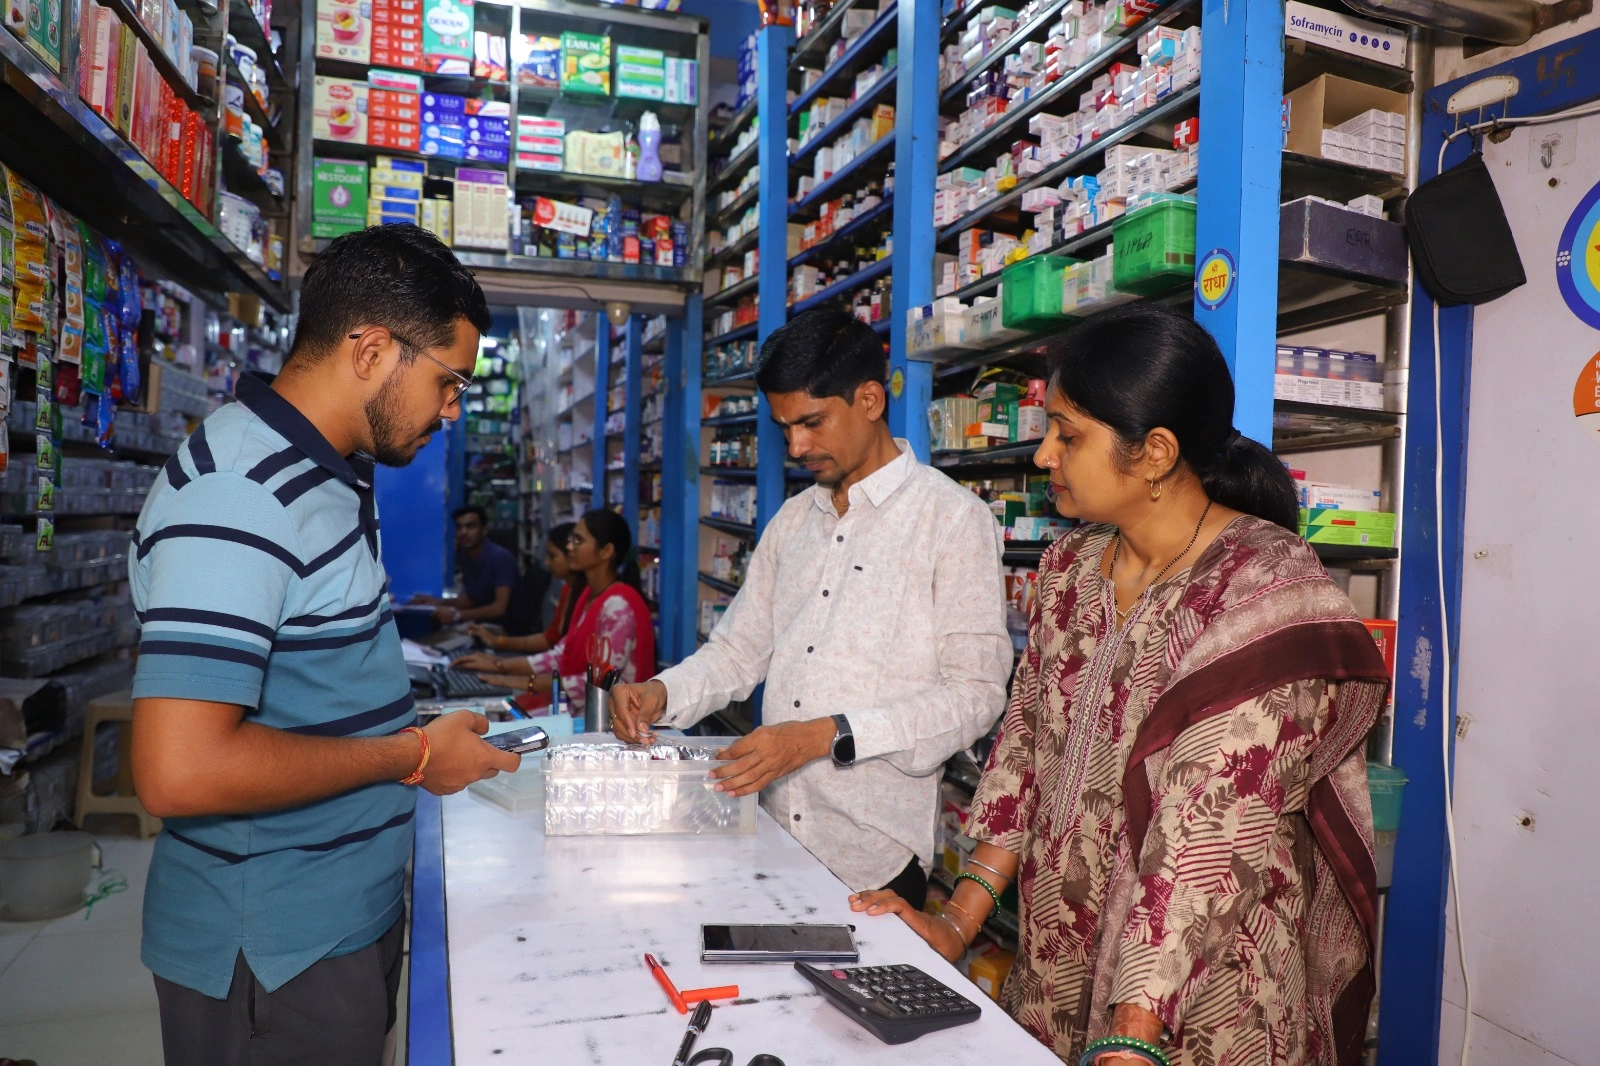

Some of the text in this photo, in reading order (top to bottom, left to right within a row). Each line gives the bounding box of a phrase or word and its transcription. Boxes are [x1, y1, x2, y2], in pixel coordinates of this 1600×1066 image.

[1290, 15, 1343, 38] Soframycin
[1346, 228, 1376, 253] EAR
[1203, 273, 1227, 293] राधा
